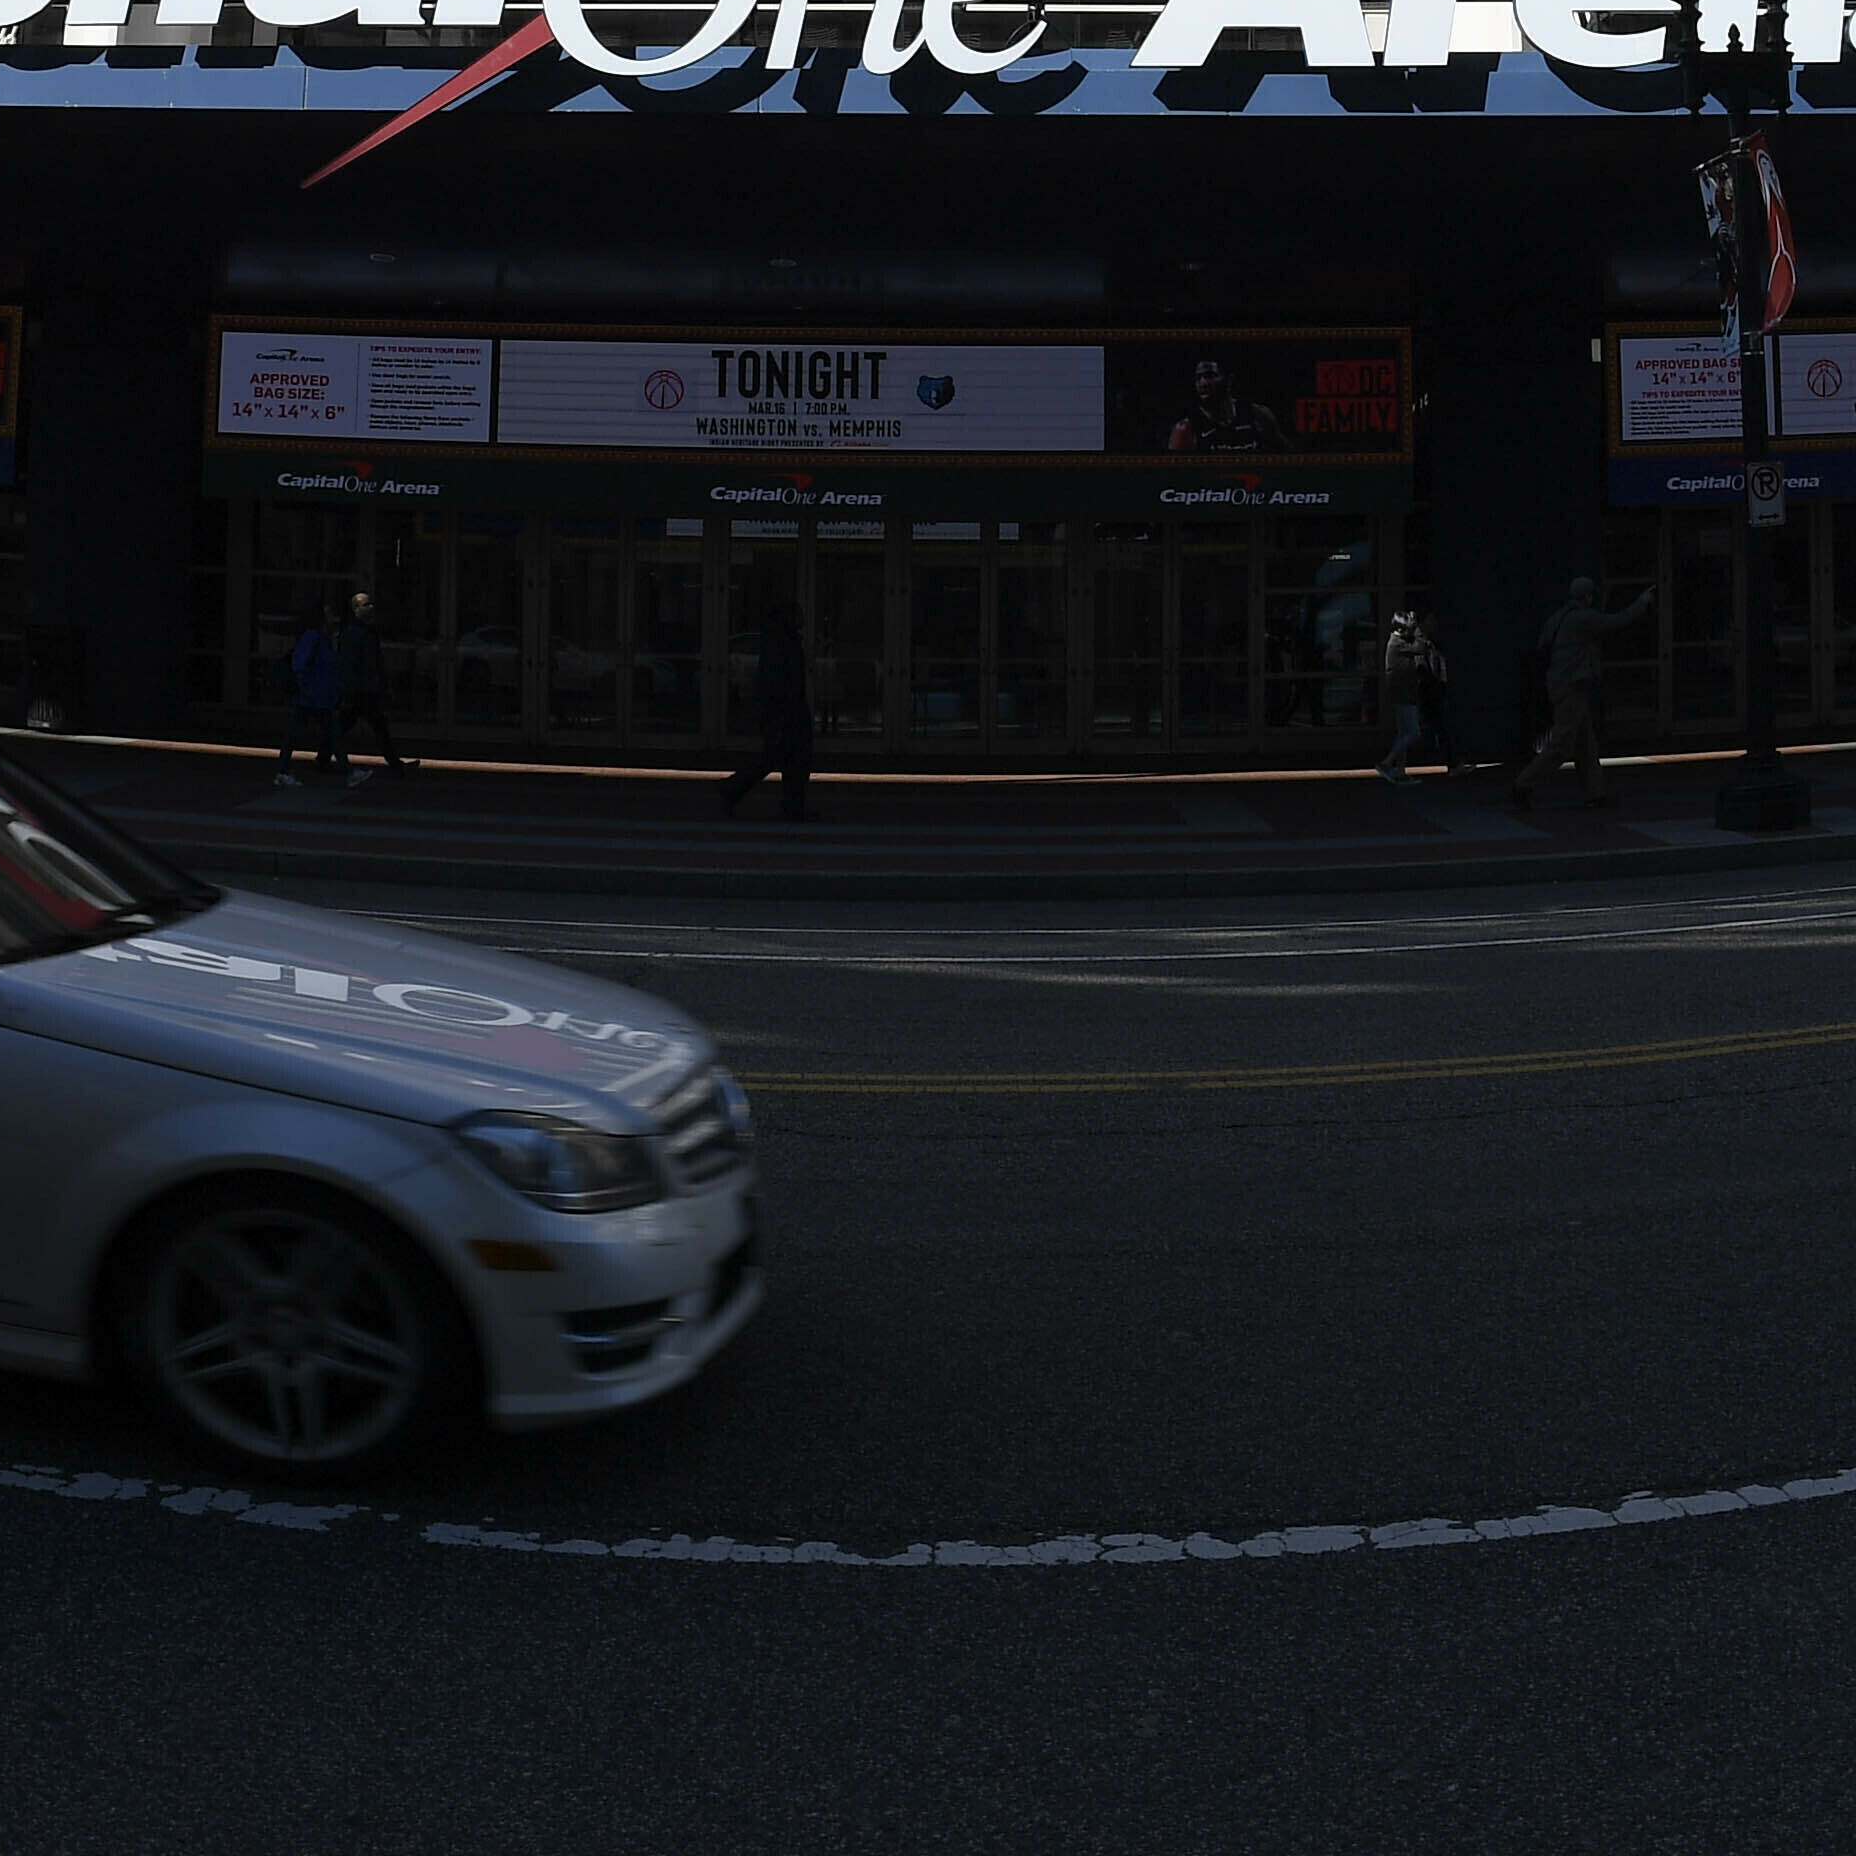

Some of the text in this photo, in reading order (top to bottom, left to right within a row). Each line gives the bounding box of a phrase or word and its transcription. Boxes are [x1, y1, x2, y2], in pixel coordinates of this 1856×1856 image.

[1635, 358, 1700, 370] APPROVED
[1703, 358, 1727, 368] BAG
[250, 373, 330, 386] APPROVED
[711, 350, 887, 400] TONIGHT
[1652, 372, 1676, 385] 14"
[1690, 371, 1713, 384] 14"
[254, 387, 325, 400] BAG SIZE:
[232, 402, 262, 417] 14"
[278, 404, 308, 418] 14"
[325, 405, 345, 420] 6"
[1302, 400, 1396, 433] FAMILY
[696, 417, 797, 437] WASHINGTON
[829, 419, 901, 438] MEMPHIS
[380, 480, 440, 496] Arena
[820, 491, 883, 506] Arena
[1269, 490, 1330, 505] Arena
